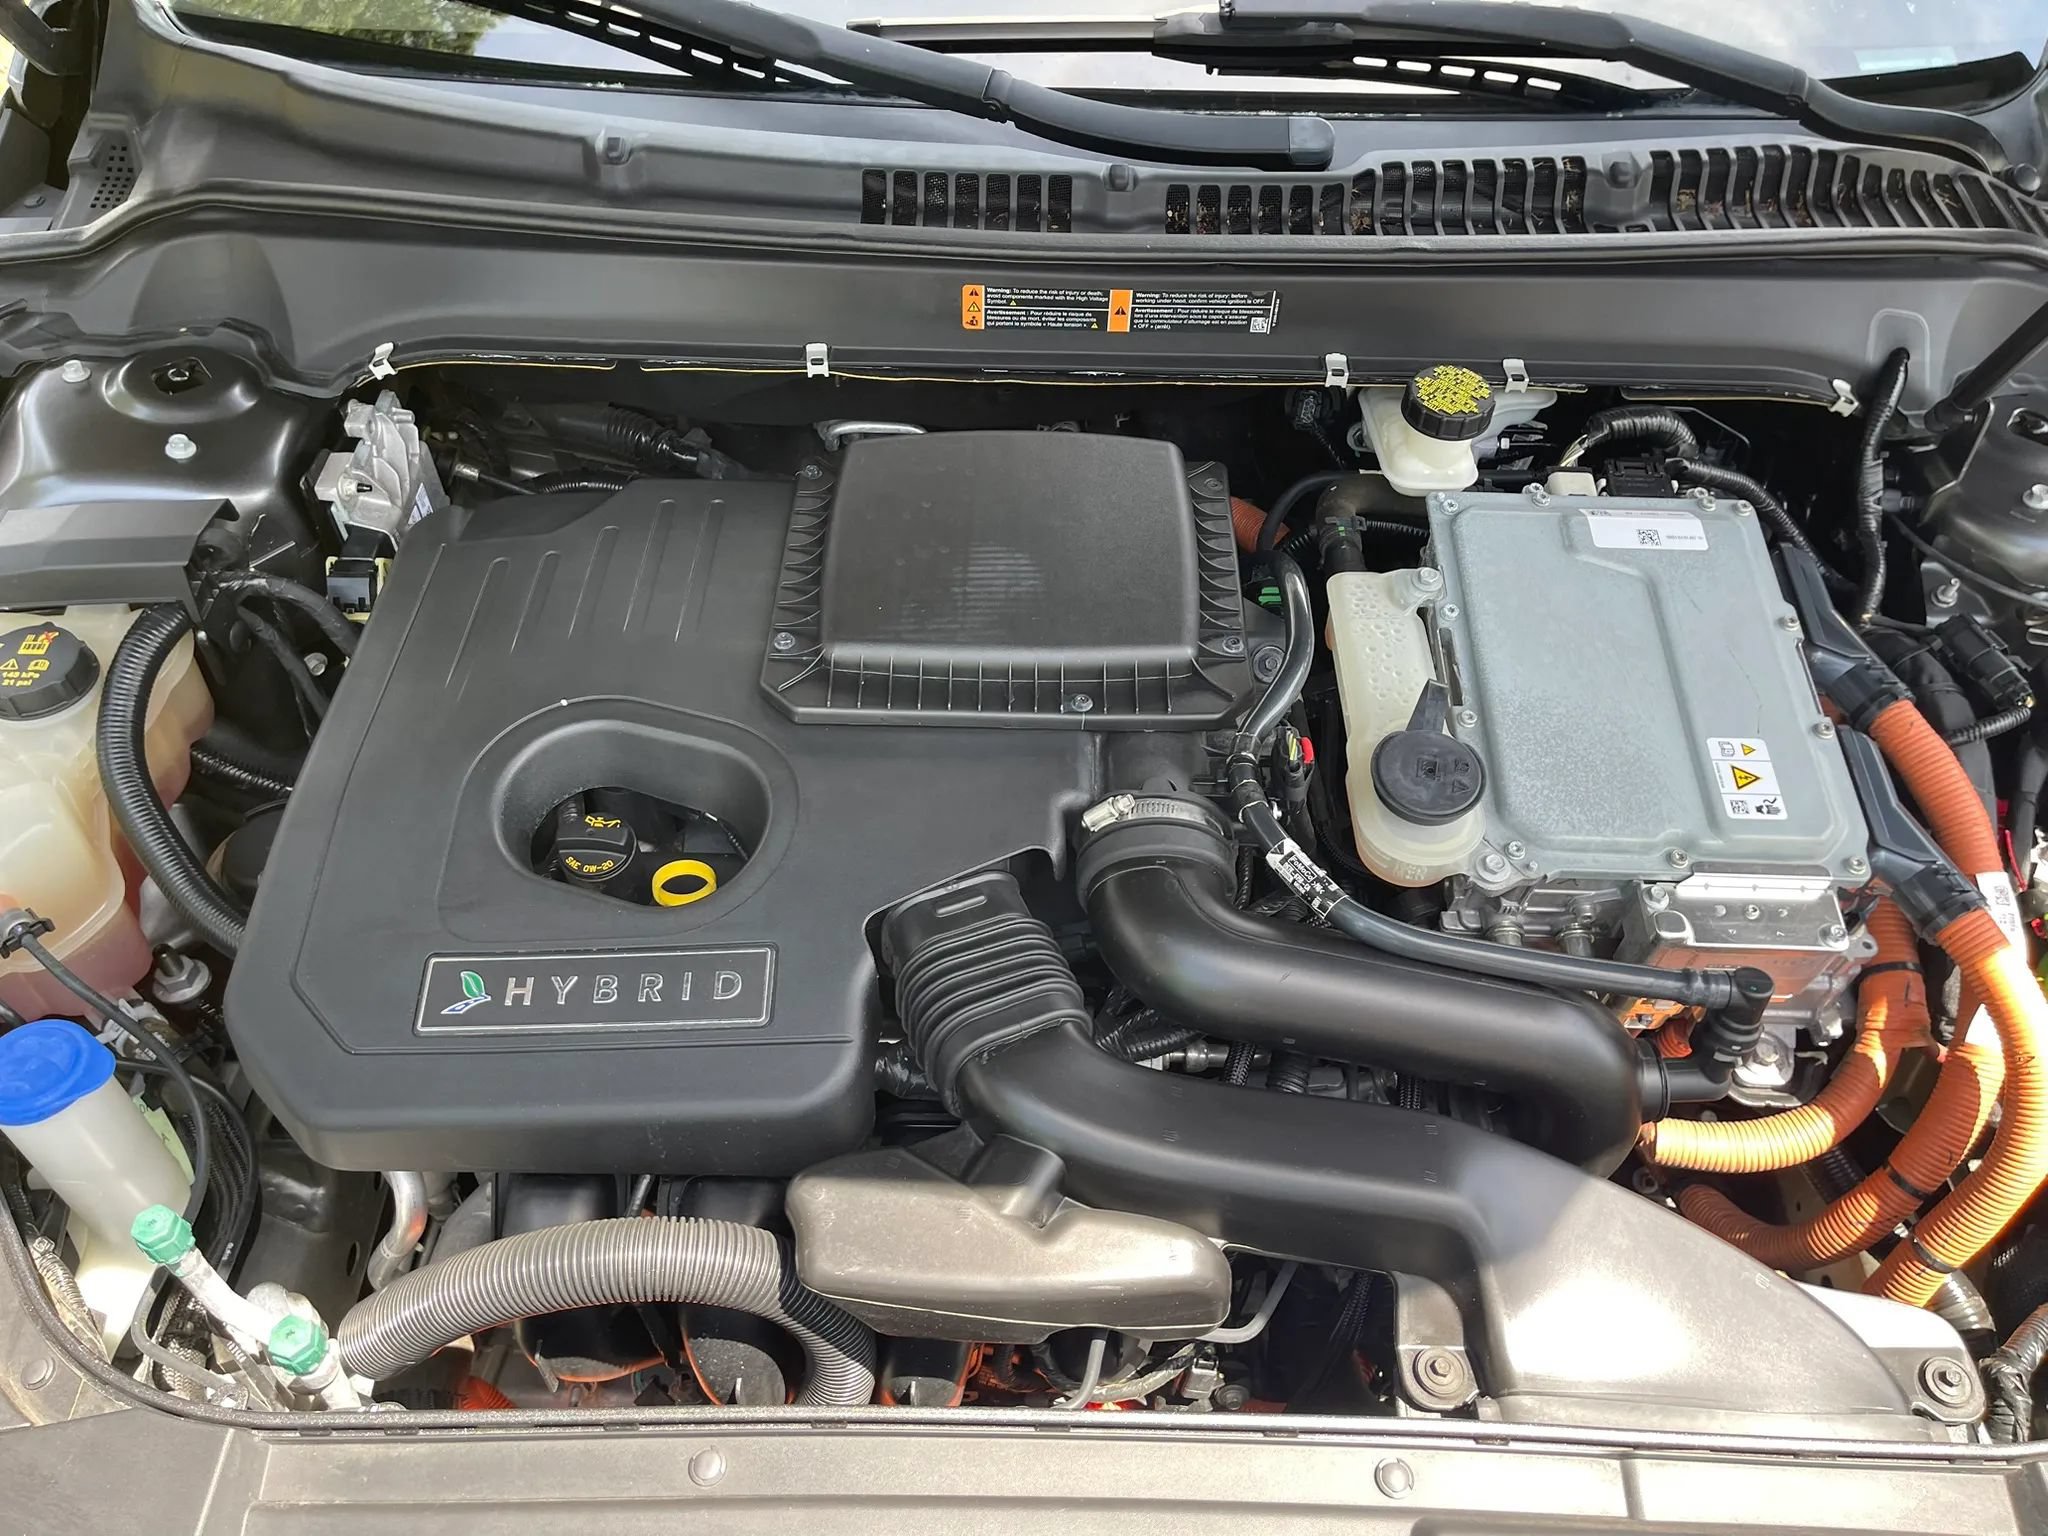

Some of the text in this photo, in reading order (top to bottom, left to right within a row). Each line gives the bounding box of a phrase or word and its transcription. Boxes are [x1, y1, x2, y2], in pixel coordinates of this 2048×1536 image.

[16, 679, 32, 687] psi
[565, 856, 614, 873] SAE 0W-20
[1289, 856, 1314, 881] FoMoCo
[504, 970, 743, 1006] HYBRID
